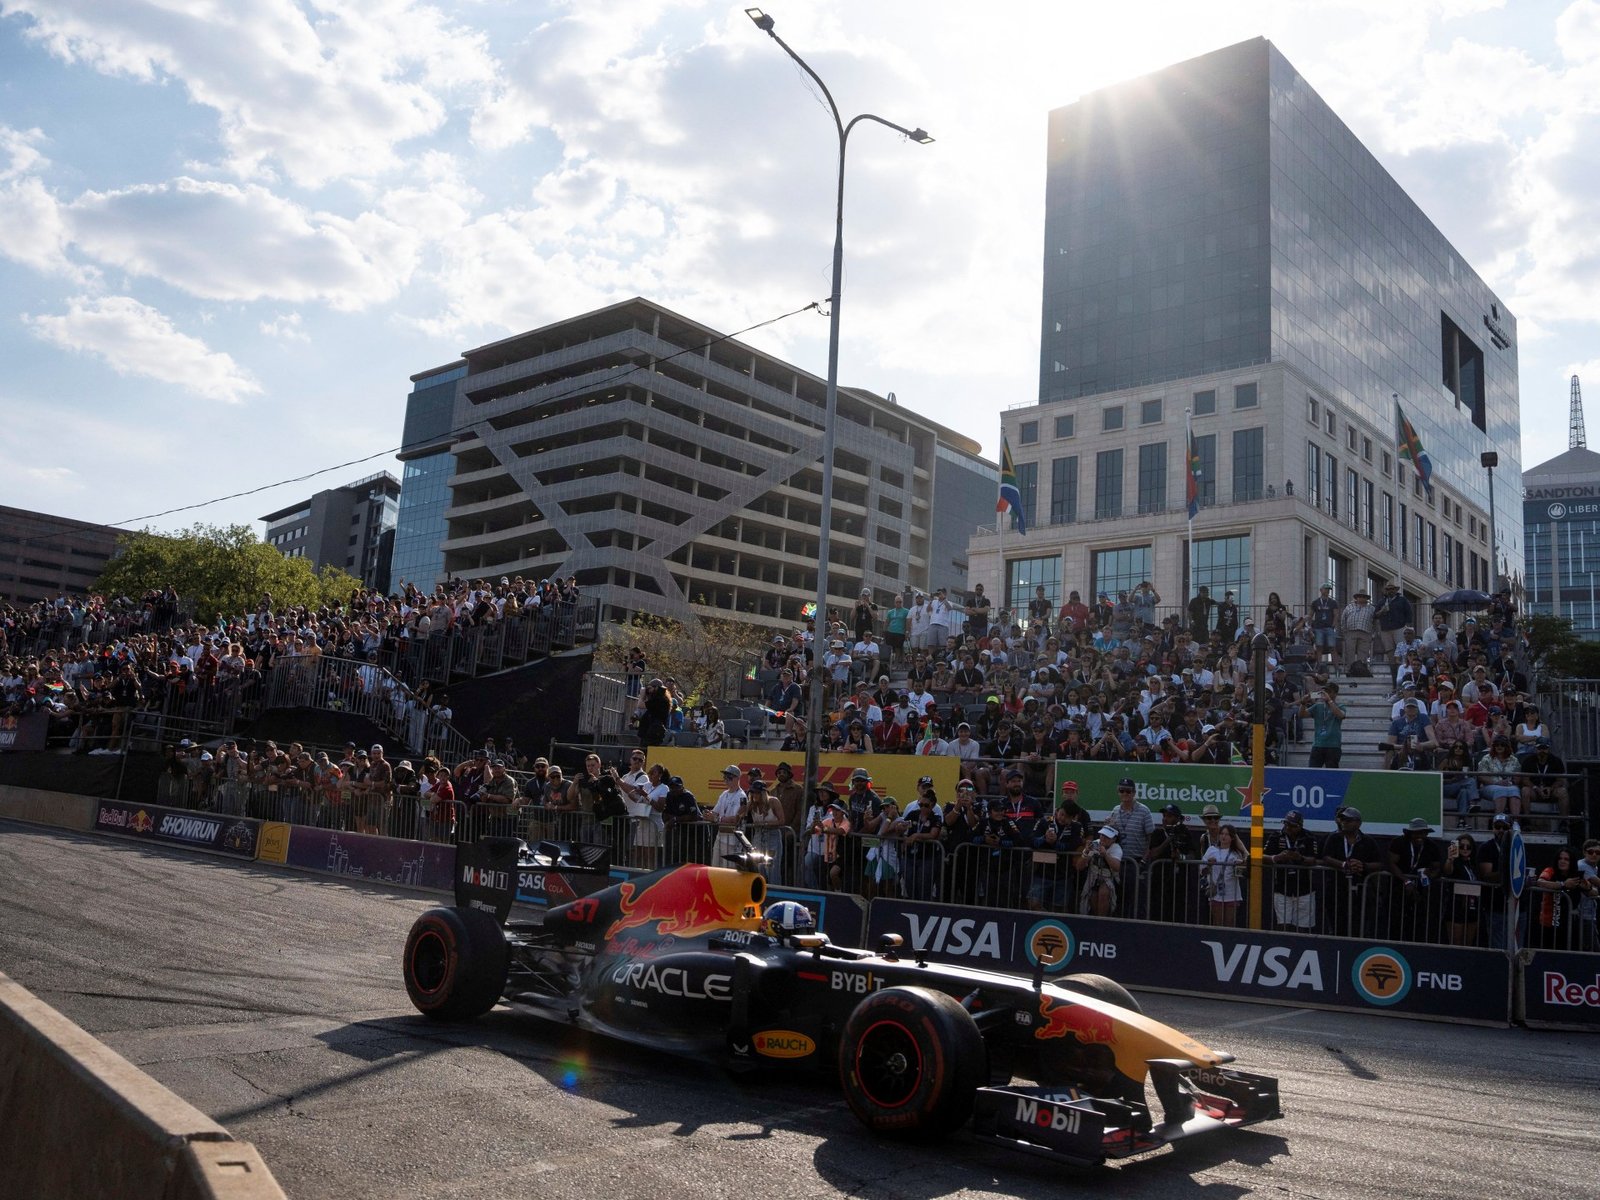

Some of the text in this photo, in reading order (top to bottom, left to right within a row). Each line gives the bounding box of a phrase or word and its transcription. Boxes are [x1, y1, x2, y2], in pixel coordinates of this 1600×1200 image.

[1526, 486, 1594, 499] SANDTON
[1134, 782, 1229, 803] Heineken
[160, 816, 220, 842] SHOWRUN
[463, 865, 495, 888] Mobil
[566, 898, 600, 924] 37
[724, 930, 753, 945] ROKT
[901, 913, 1116, 958] VISA FNB
[1201, 940, 1462, 991] VISA FNB
[612, 963, 733, 1000] ORACLE
[831, 971, 885, 994] BYBIT
[1015, 1012, 1032, 1023] FIA
[766, 1037, 807, 1051] RAUCH
[1188, 1068, 1227, 1087] Claro
[1015, 1098, 1081, 1135] Mobil
